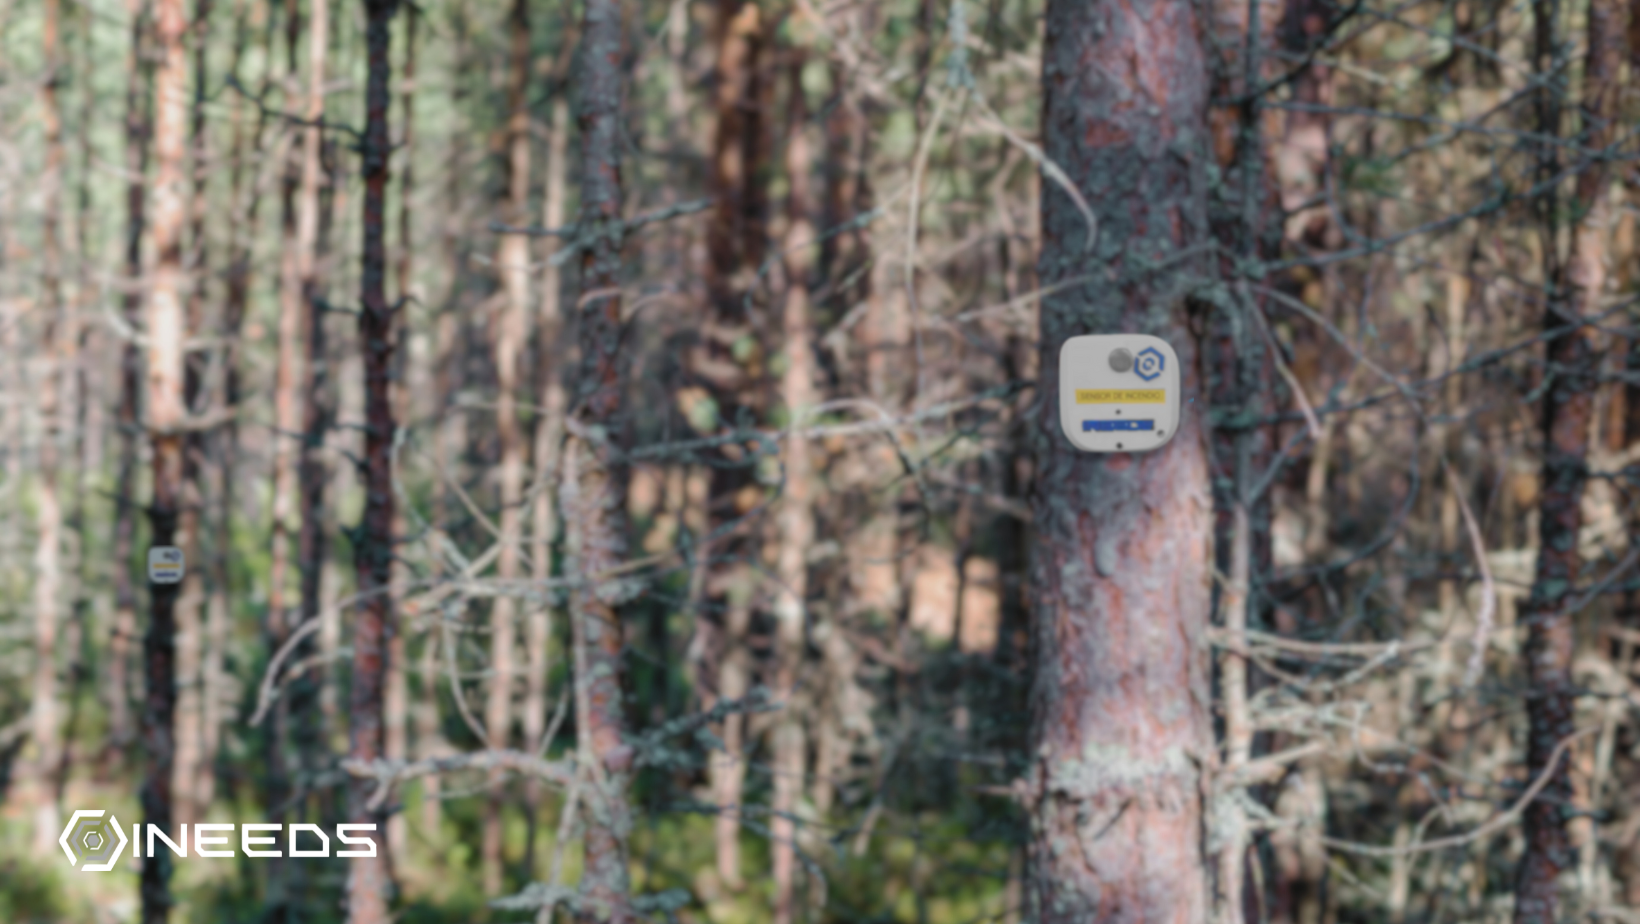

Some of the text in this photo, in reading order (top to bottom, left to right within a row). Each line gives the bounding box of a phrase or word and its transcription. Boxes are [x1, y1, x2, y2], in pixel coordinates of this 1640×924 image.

[1080, 391, 1160, 400] SENSOR DE INCENDIO
